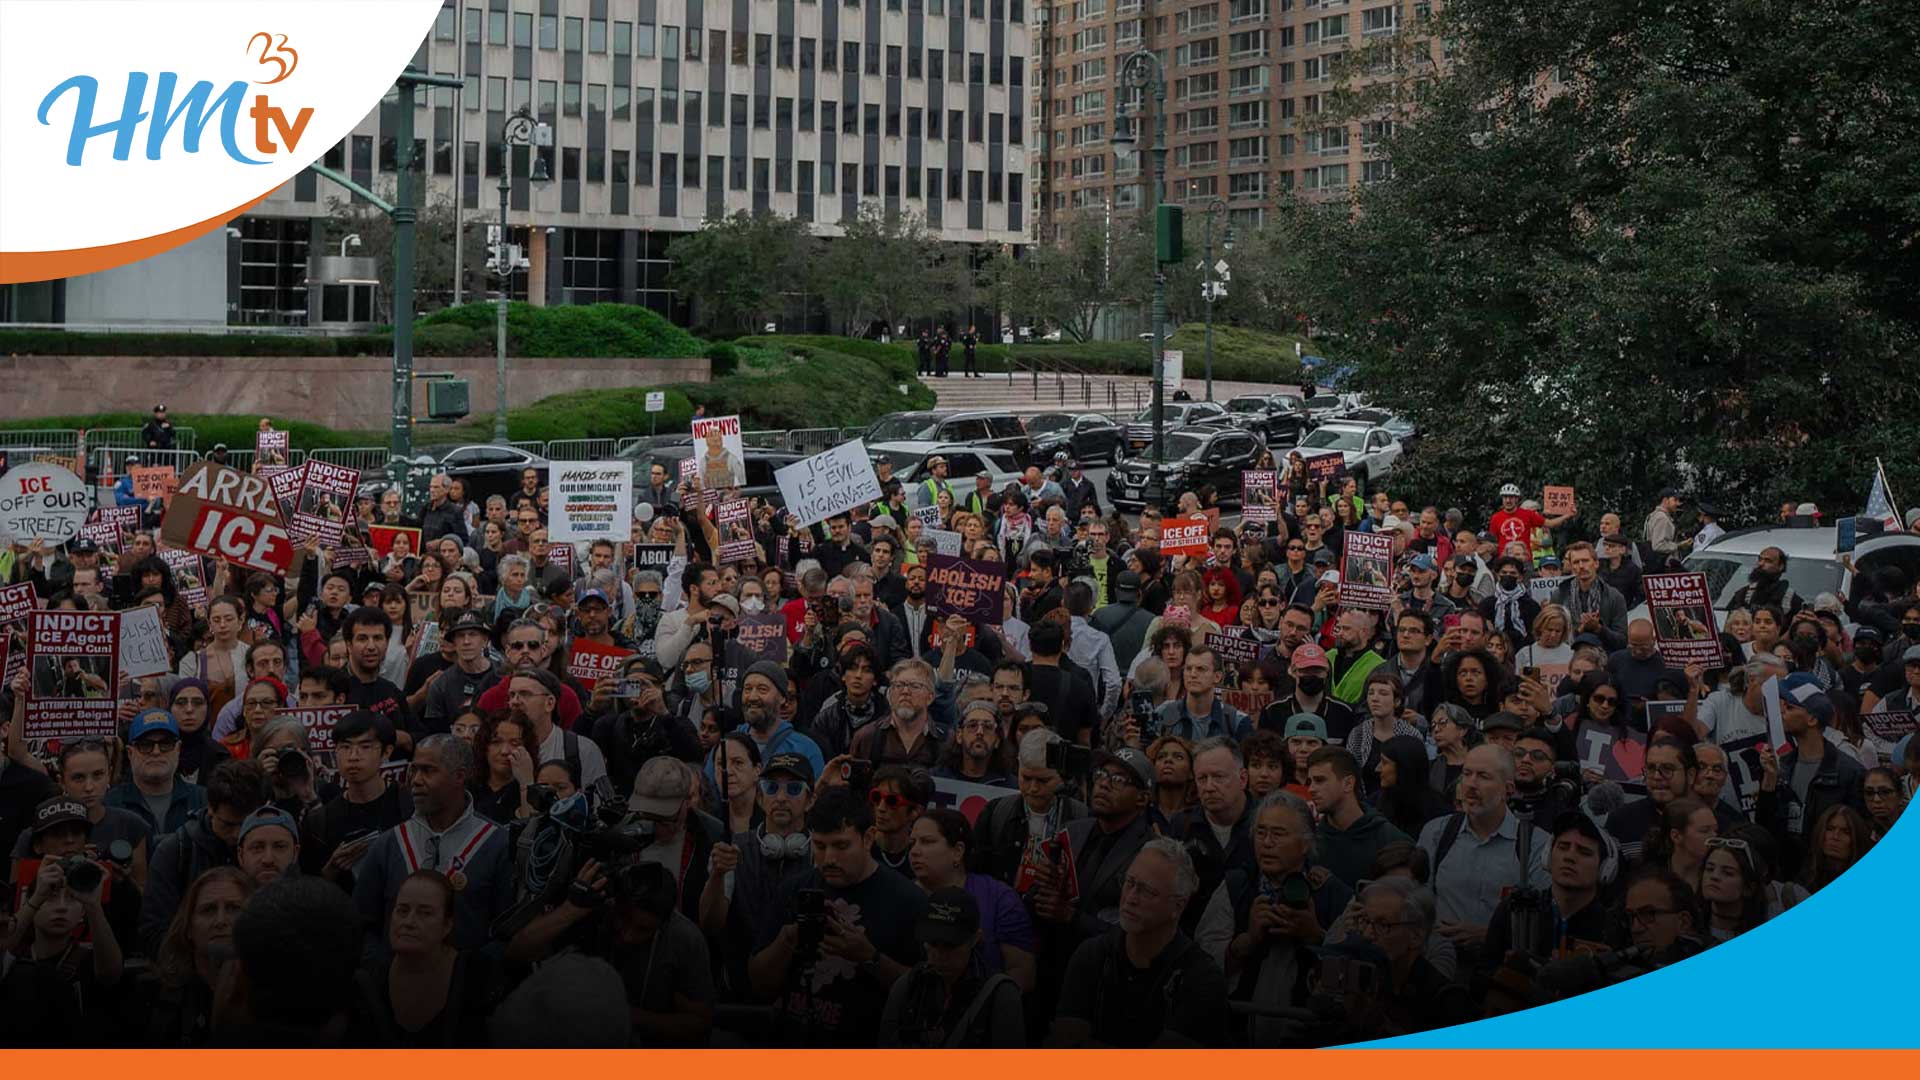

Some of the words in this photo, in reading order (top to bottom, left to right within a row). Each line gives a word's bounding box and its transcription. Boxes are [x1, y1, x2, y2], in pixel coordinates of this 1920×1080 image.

[719, 418, 738, 436] NYC
[309, 462, 355, 482] INDICT
[807, 452, 838, 478] ICE
[272, 469, 305, 489] INDIC
[307, 473, 324, 484] ICE
[561, 471, 600, 482] HANDS
[799, 479, 816, 500] IS
[825, 462, 866, 488] EVIL
[1244, 471, 1273, 481] INDICT
[19, 476, 53, 495] ICE
[179, 466, 277, 517] ARRE
[0, 495, 36, 511] OFF
[43, 491, 87, 508] OUR
[798, 479, 877, 523] INCARNATE
[101, 507, 138, 518] INDICT
[8, 516, 76, 537] STREETS
[1164, 528, 1183, 540] ICE
[1183, 525, 1205, 538] OFF
[1349, 534, 1391, 548] INDICT
[1349, 544, 1364, 553] ICE
[929, 567, 1003, 592] ABOLISH
[1648, 576, 1703, 591] INDICT
[945, 588, 977, 607] ICE
[1650, 589, 1670, 600] ICE
[1672, 588, 1704, 600] Agent
[35, 614, 115, 632] INDICT
[739, 624, 784, 638] OLISH
[35, 630, 63, 643] ICE
[65, 631, 113, 646] Agent
[746, 638, 766, 652] CE
[1208, 634, 1259, 655] INDICT
[35, 643, 83, 653] Brendan
[573, 652, 600, 668] ICE
[601, 655, 627, 671] OF
[41, 710, 74, 721] Oscar
[38, 802, 88, 820] GOLDEN
